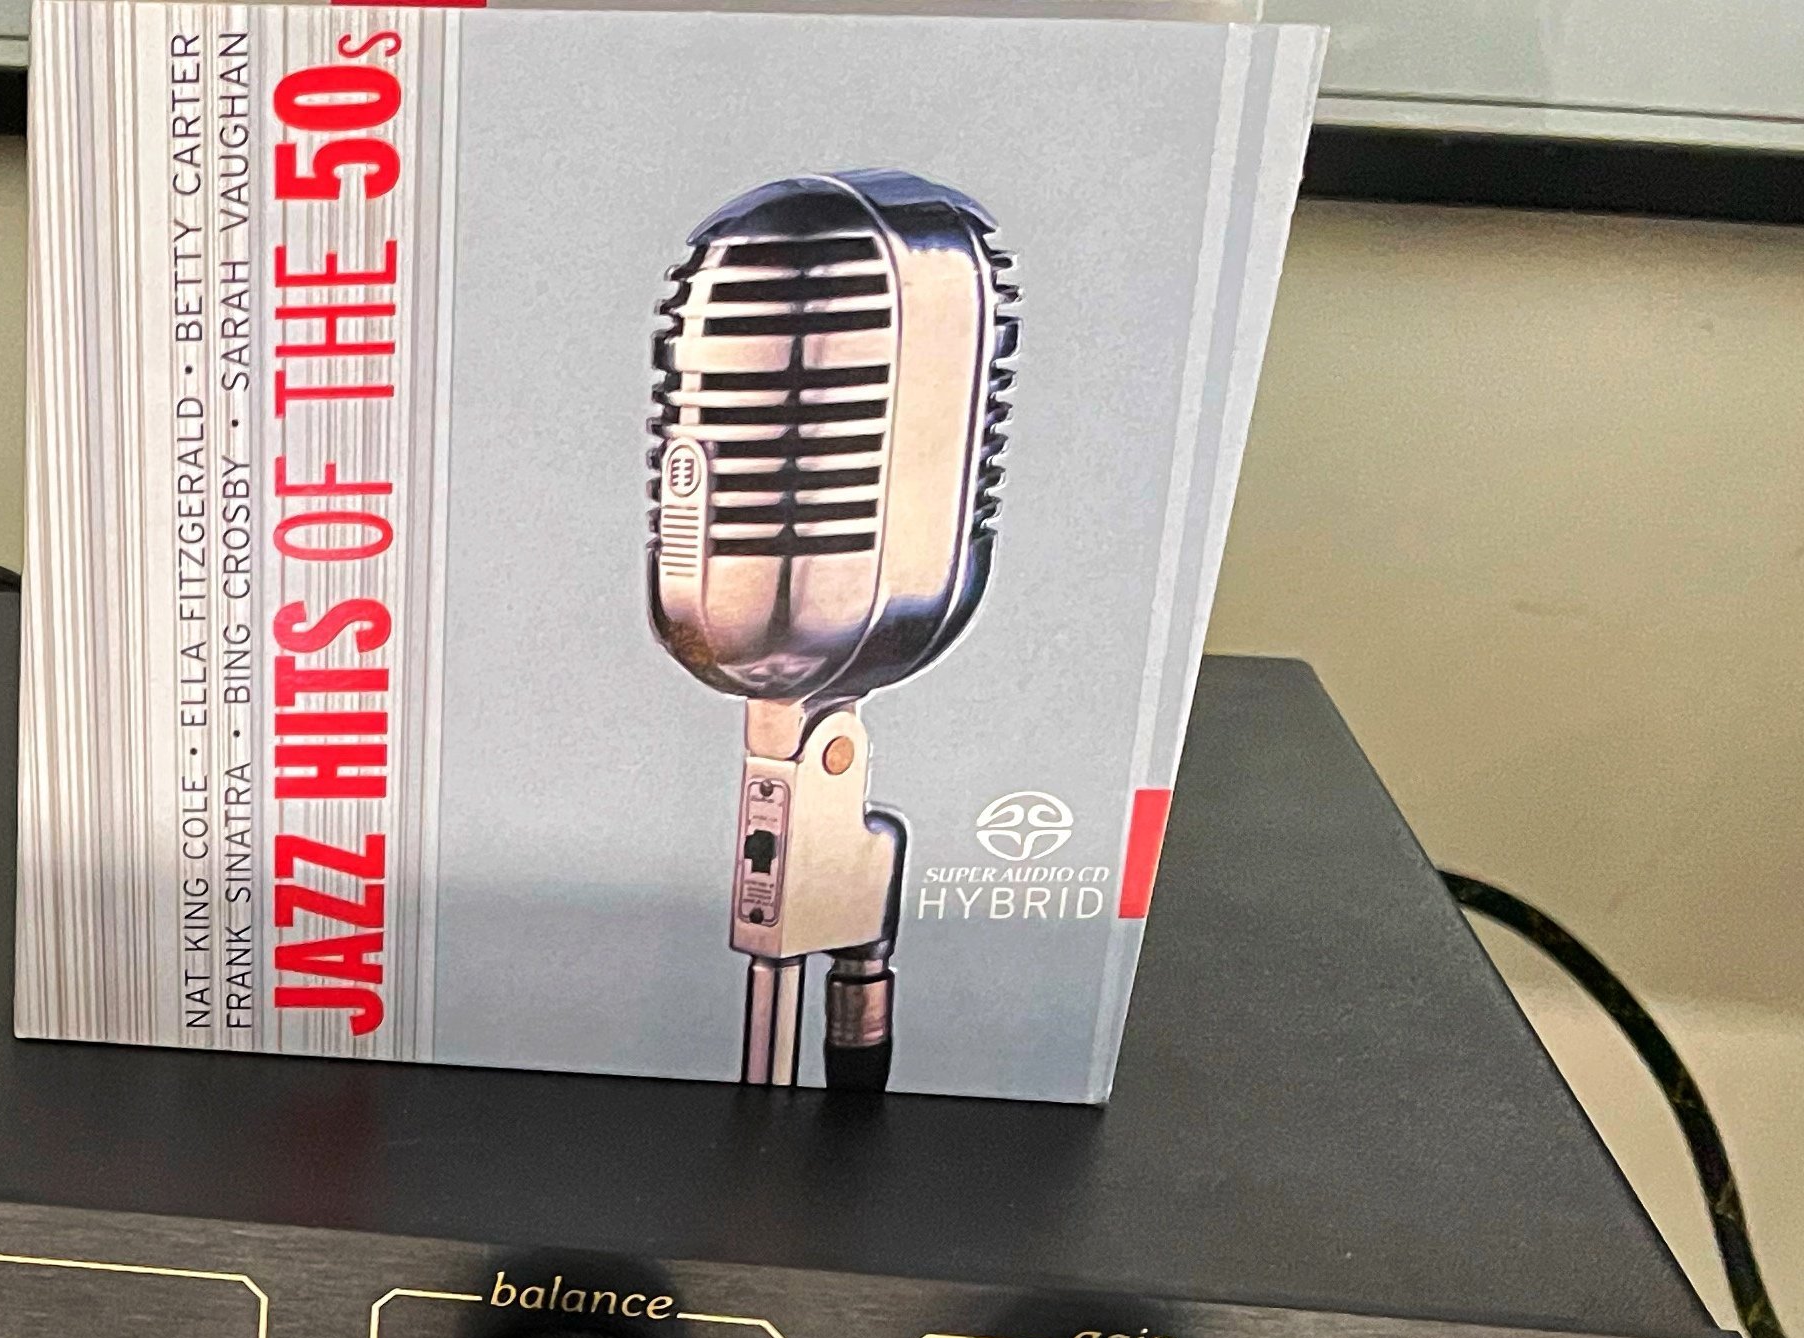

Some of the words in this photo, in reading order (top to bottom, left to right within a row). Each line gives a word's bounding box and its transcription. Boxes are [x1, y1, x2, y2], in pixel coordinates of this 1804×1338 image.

[170, 33, 202, 196] CARTER
[218, 31, 250, 234] VAUGHAN
[173, 219, 204, 343] BETTY
[220, 260, 251, 392] SARAH
[274, 240, 397, 420] THE
[176, 397, 208, 624] FITZGERALD
[221, 455, 252, 602] CROSBY
[272, 456, 394, 562] OF
[180, 642, 209, 728] ELLA
[223, 622, 251, 704] BING
[273, 598, 392, 800] HITS
[181, 775, 210, 860] COLE
[224, 760, 252, 904] SINATRA
[924, 866, 996, 884] SUPER
[998, 866, 1074, 883] AUDIO
[1078, 866, 1110, 882] CD
[184, 877, 211, 962] KING
[274, 833, 386, 1037] JAZZ
[917, 886, 1104, 920] HYBRID
[184, 971, 211, 1030] NAT
[225, 925, 253, 1030] FRANK
[489, 1271, 675, 1320] balance
